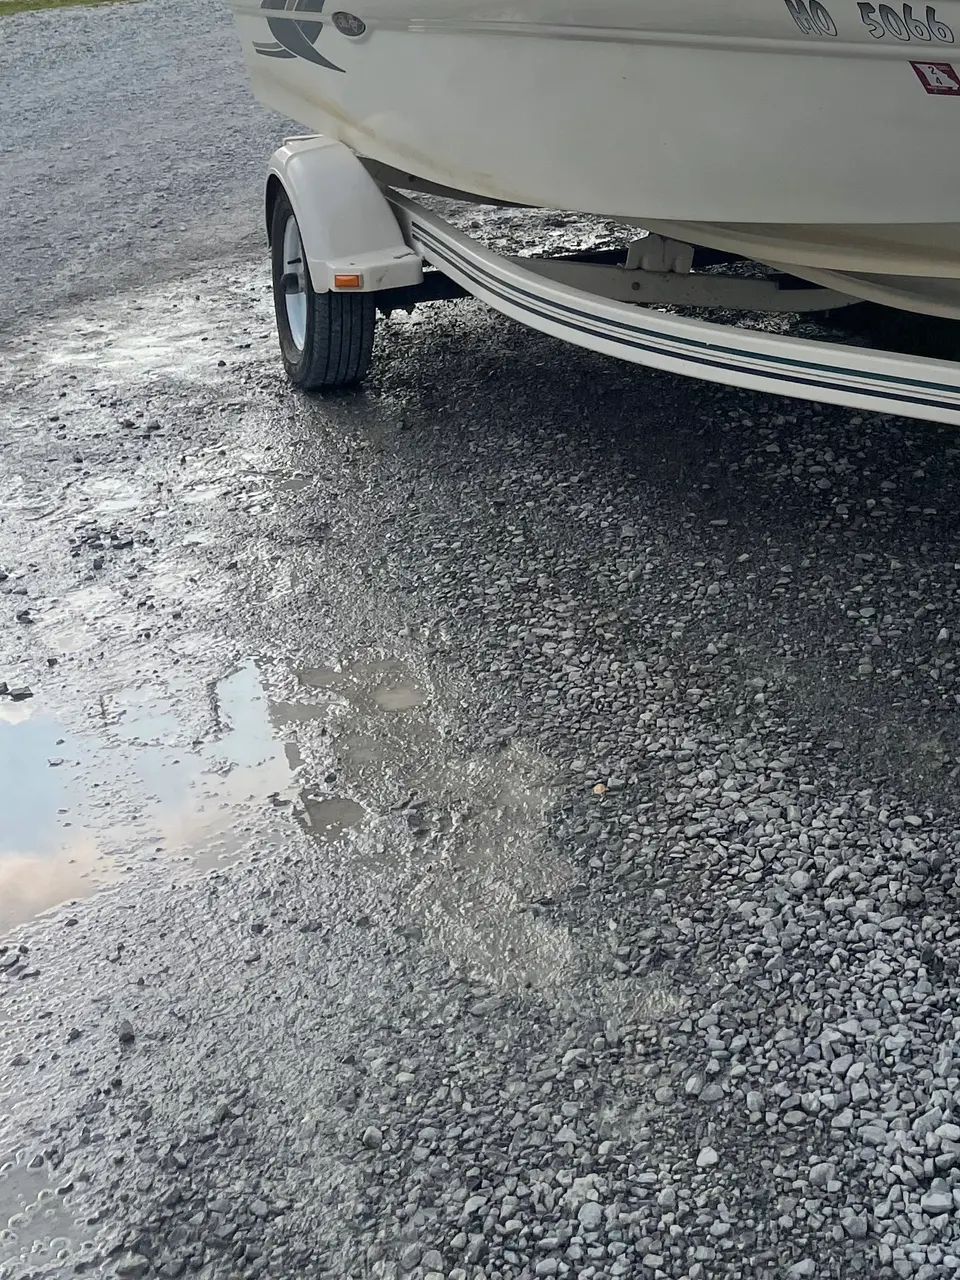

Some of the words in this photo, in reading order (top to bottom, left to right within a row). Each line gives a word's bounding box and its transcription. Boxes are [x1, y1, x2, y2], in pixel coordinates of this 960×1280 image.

[856, 1, 955, 44] 5066
[928, 65, 938, 75] 2
[935, 76, 943, 86] 4
